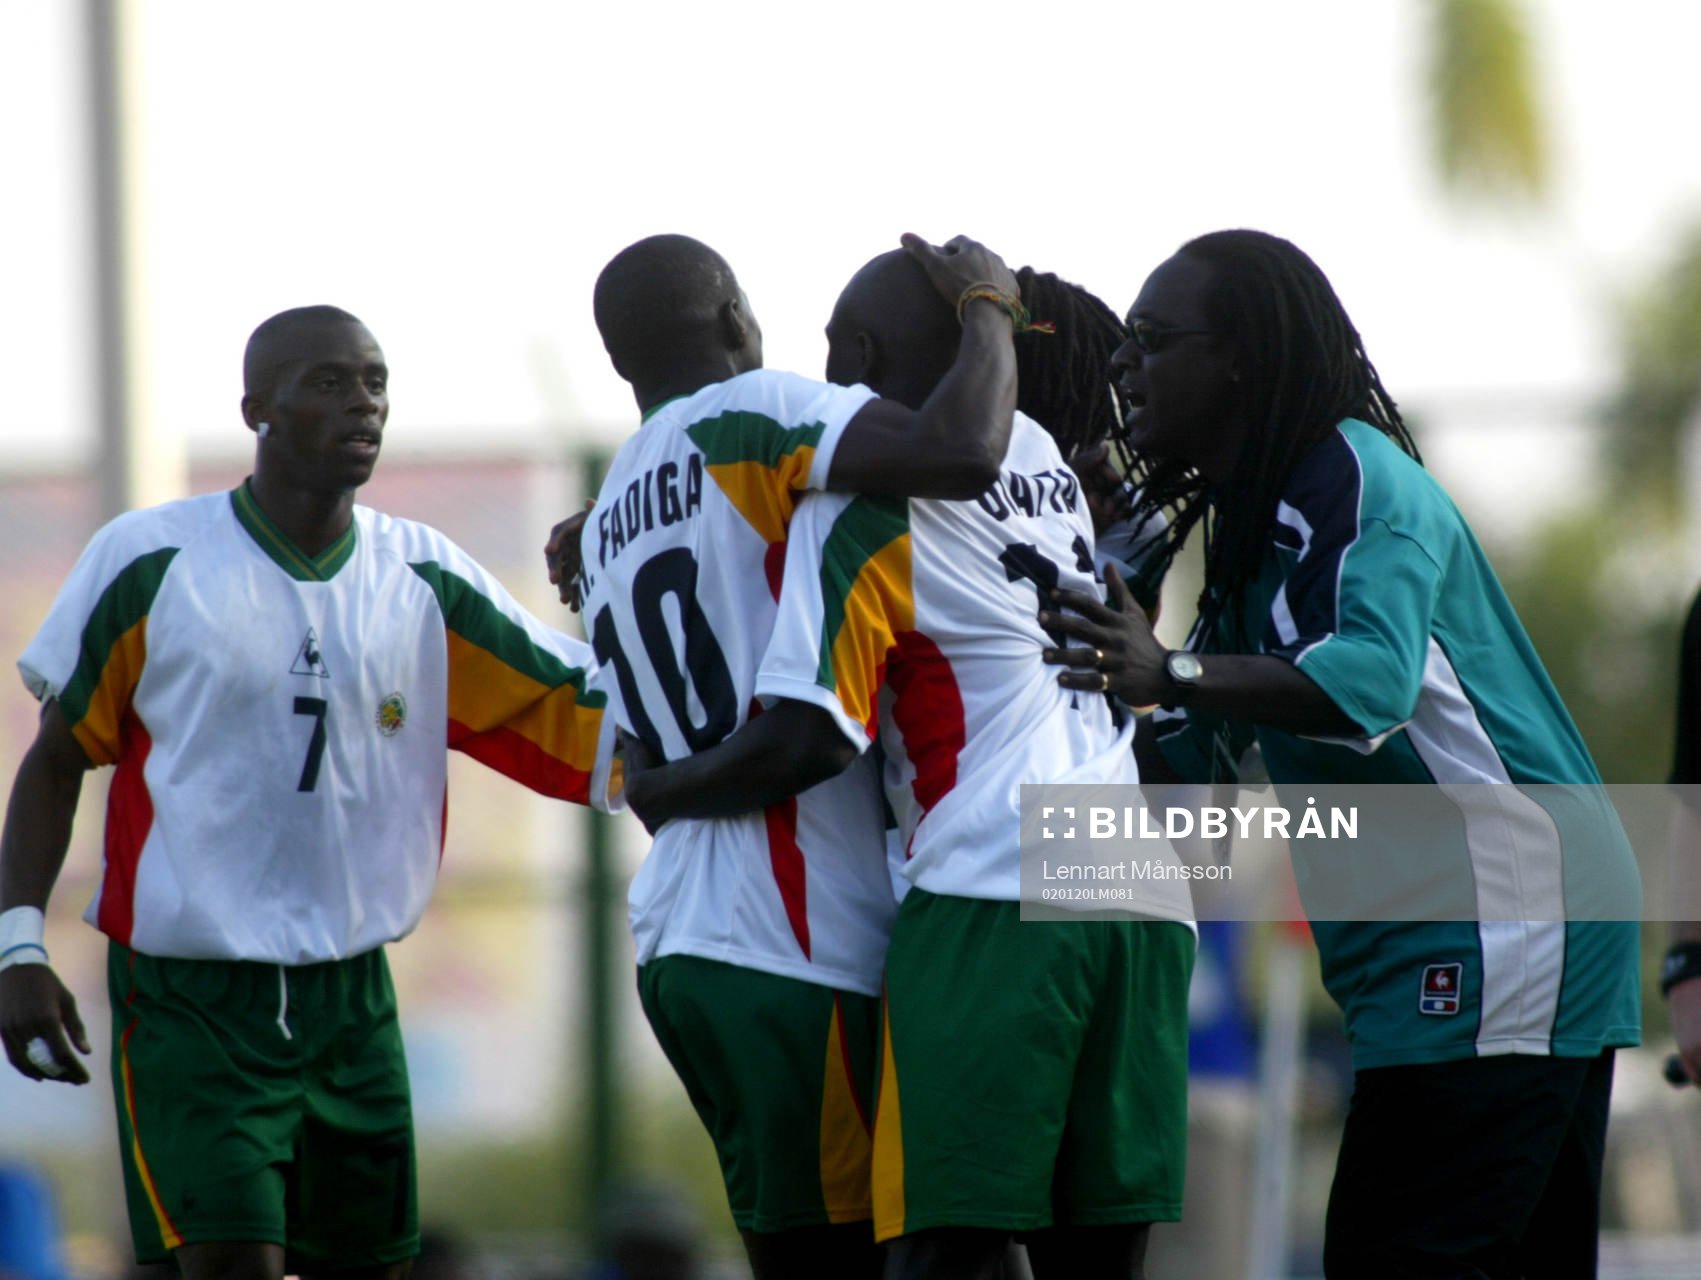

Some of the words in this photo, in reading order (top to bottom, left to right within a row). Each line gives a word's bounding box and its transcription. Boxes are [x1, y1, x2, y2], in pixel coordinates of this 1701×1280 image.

[599, 453, 703, 570] FADIGA
[592, 546, 739, 765] 10
[293, 696, 328, 792] 7
